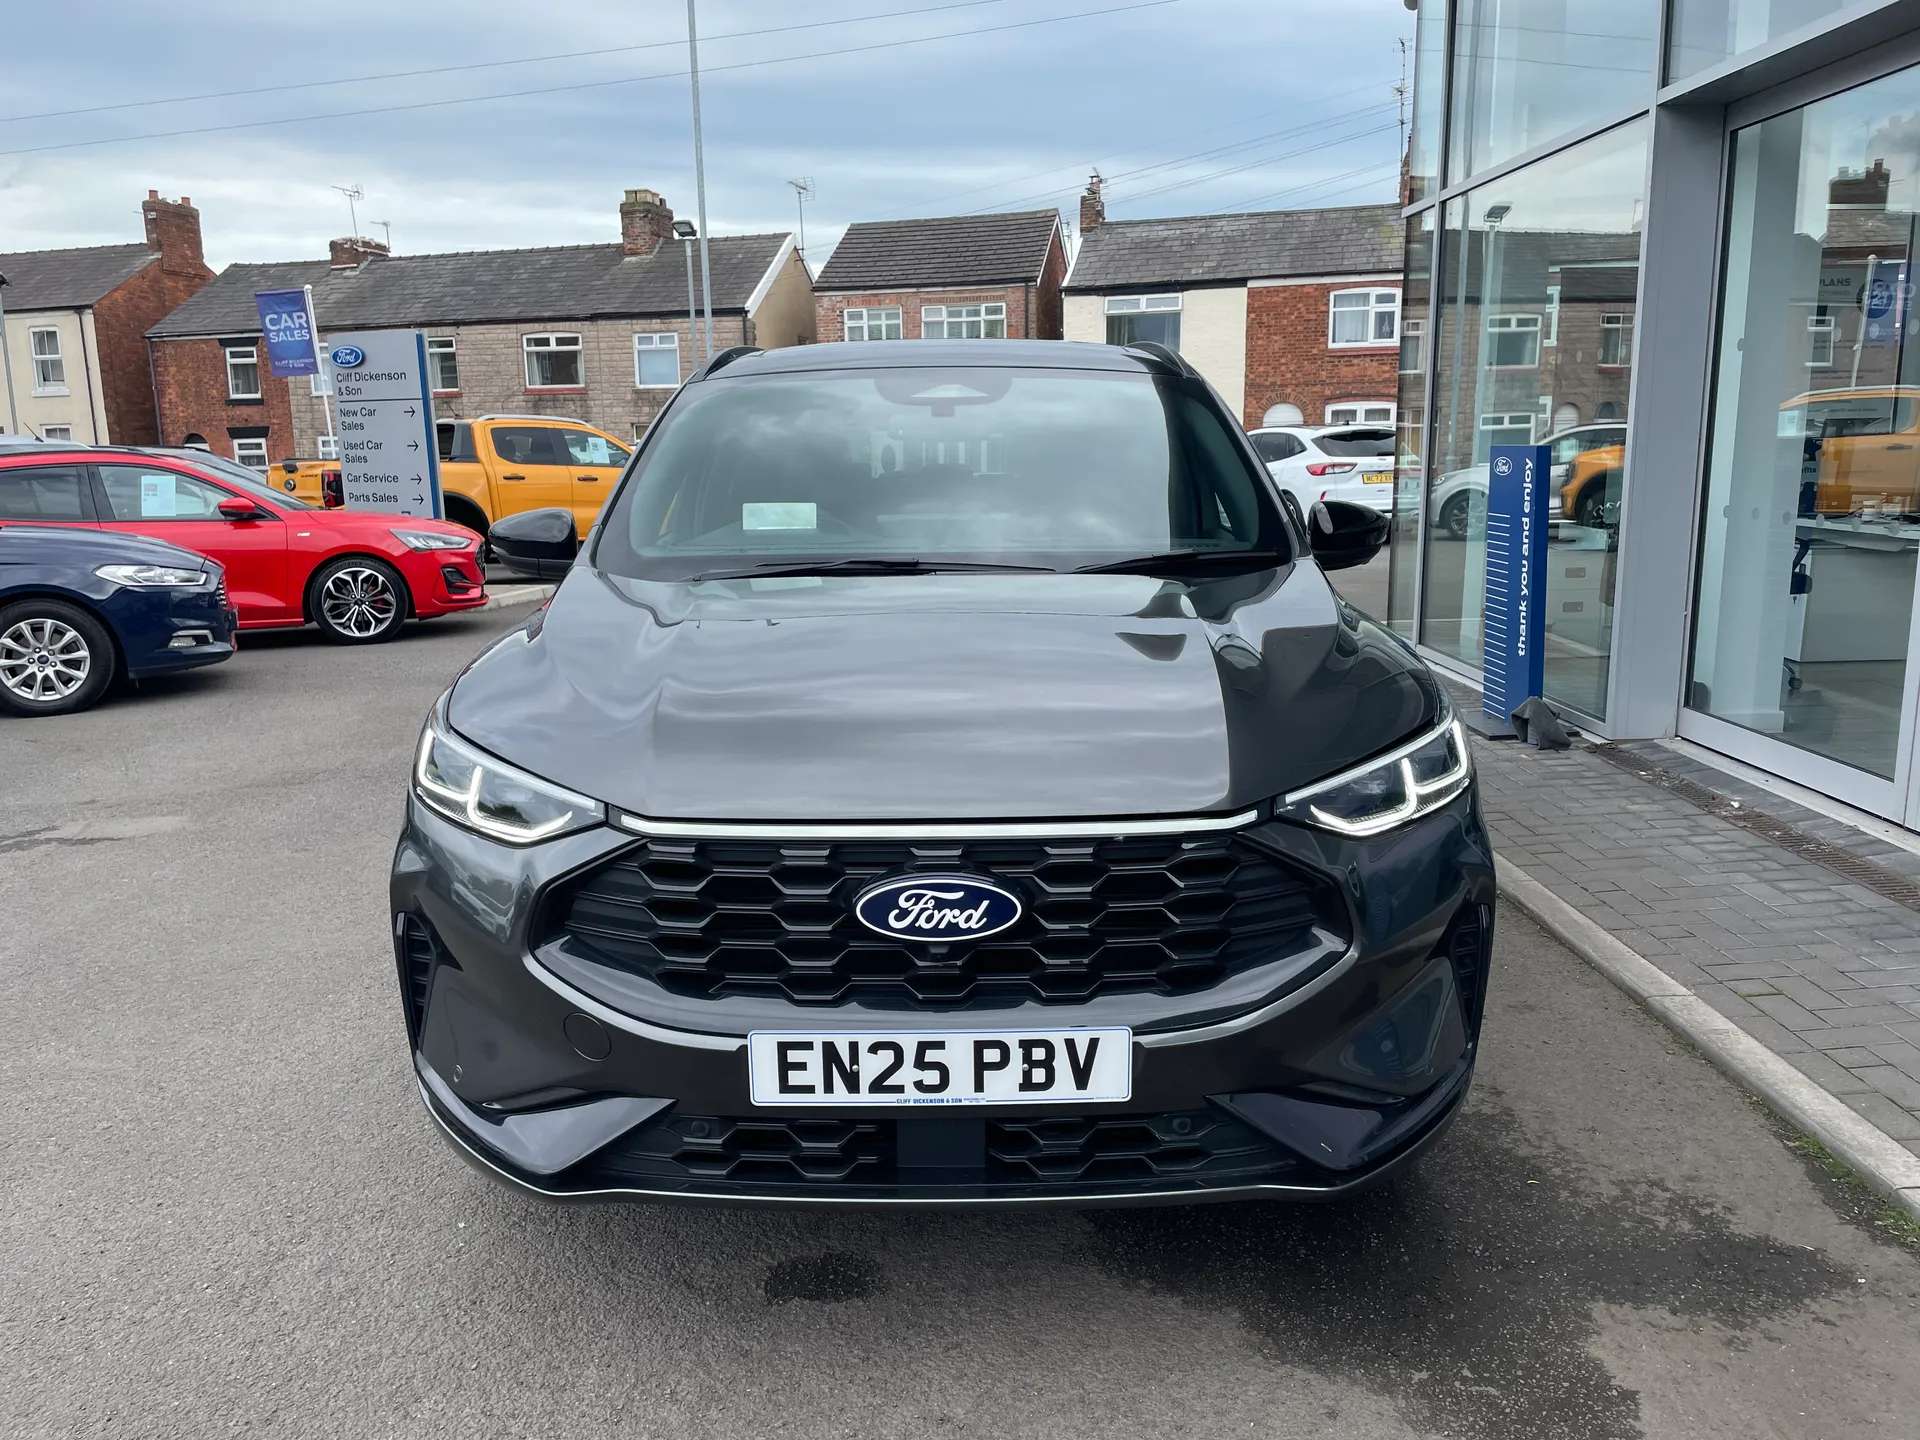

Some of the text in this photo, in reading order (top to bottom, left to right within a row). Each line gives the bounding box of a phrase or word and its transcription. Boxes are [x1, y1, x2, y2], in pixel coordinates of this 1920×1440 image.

[265, 311, 308, 330] CAR
[269, 329, 310, 343] SALES
[336, 371, 407, 383] Cliff Dickenson
[338, 386, 362, 396] & Son
[339, 406, 377, 417] New Car
[341, 420, 365, 431] Sales
[343, 440, 383, 450] Used Car
[345, 453, 368, 464] Sales
[346, 472, 399, 483] Car Service
[348, 492, 399, 503] Parts Sales
[1517, 458, 1534, 656] thank you and enjoy
[887, 889, 990, 929] Ford
[776, 1037, 1101, 1095] EN25 PBV
